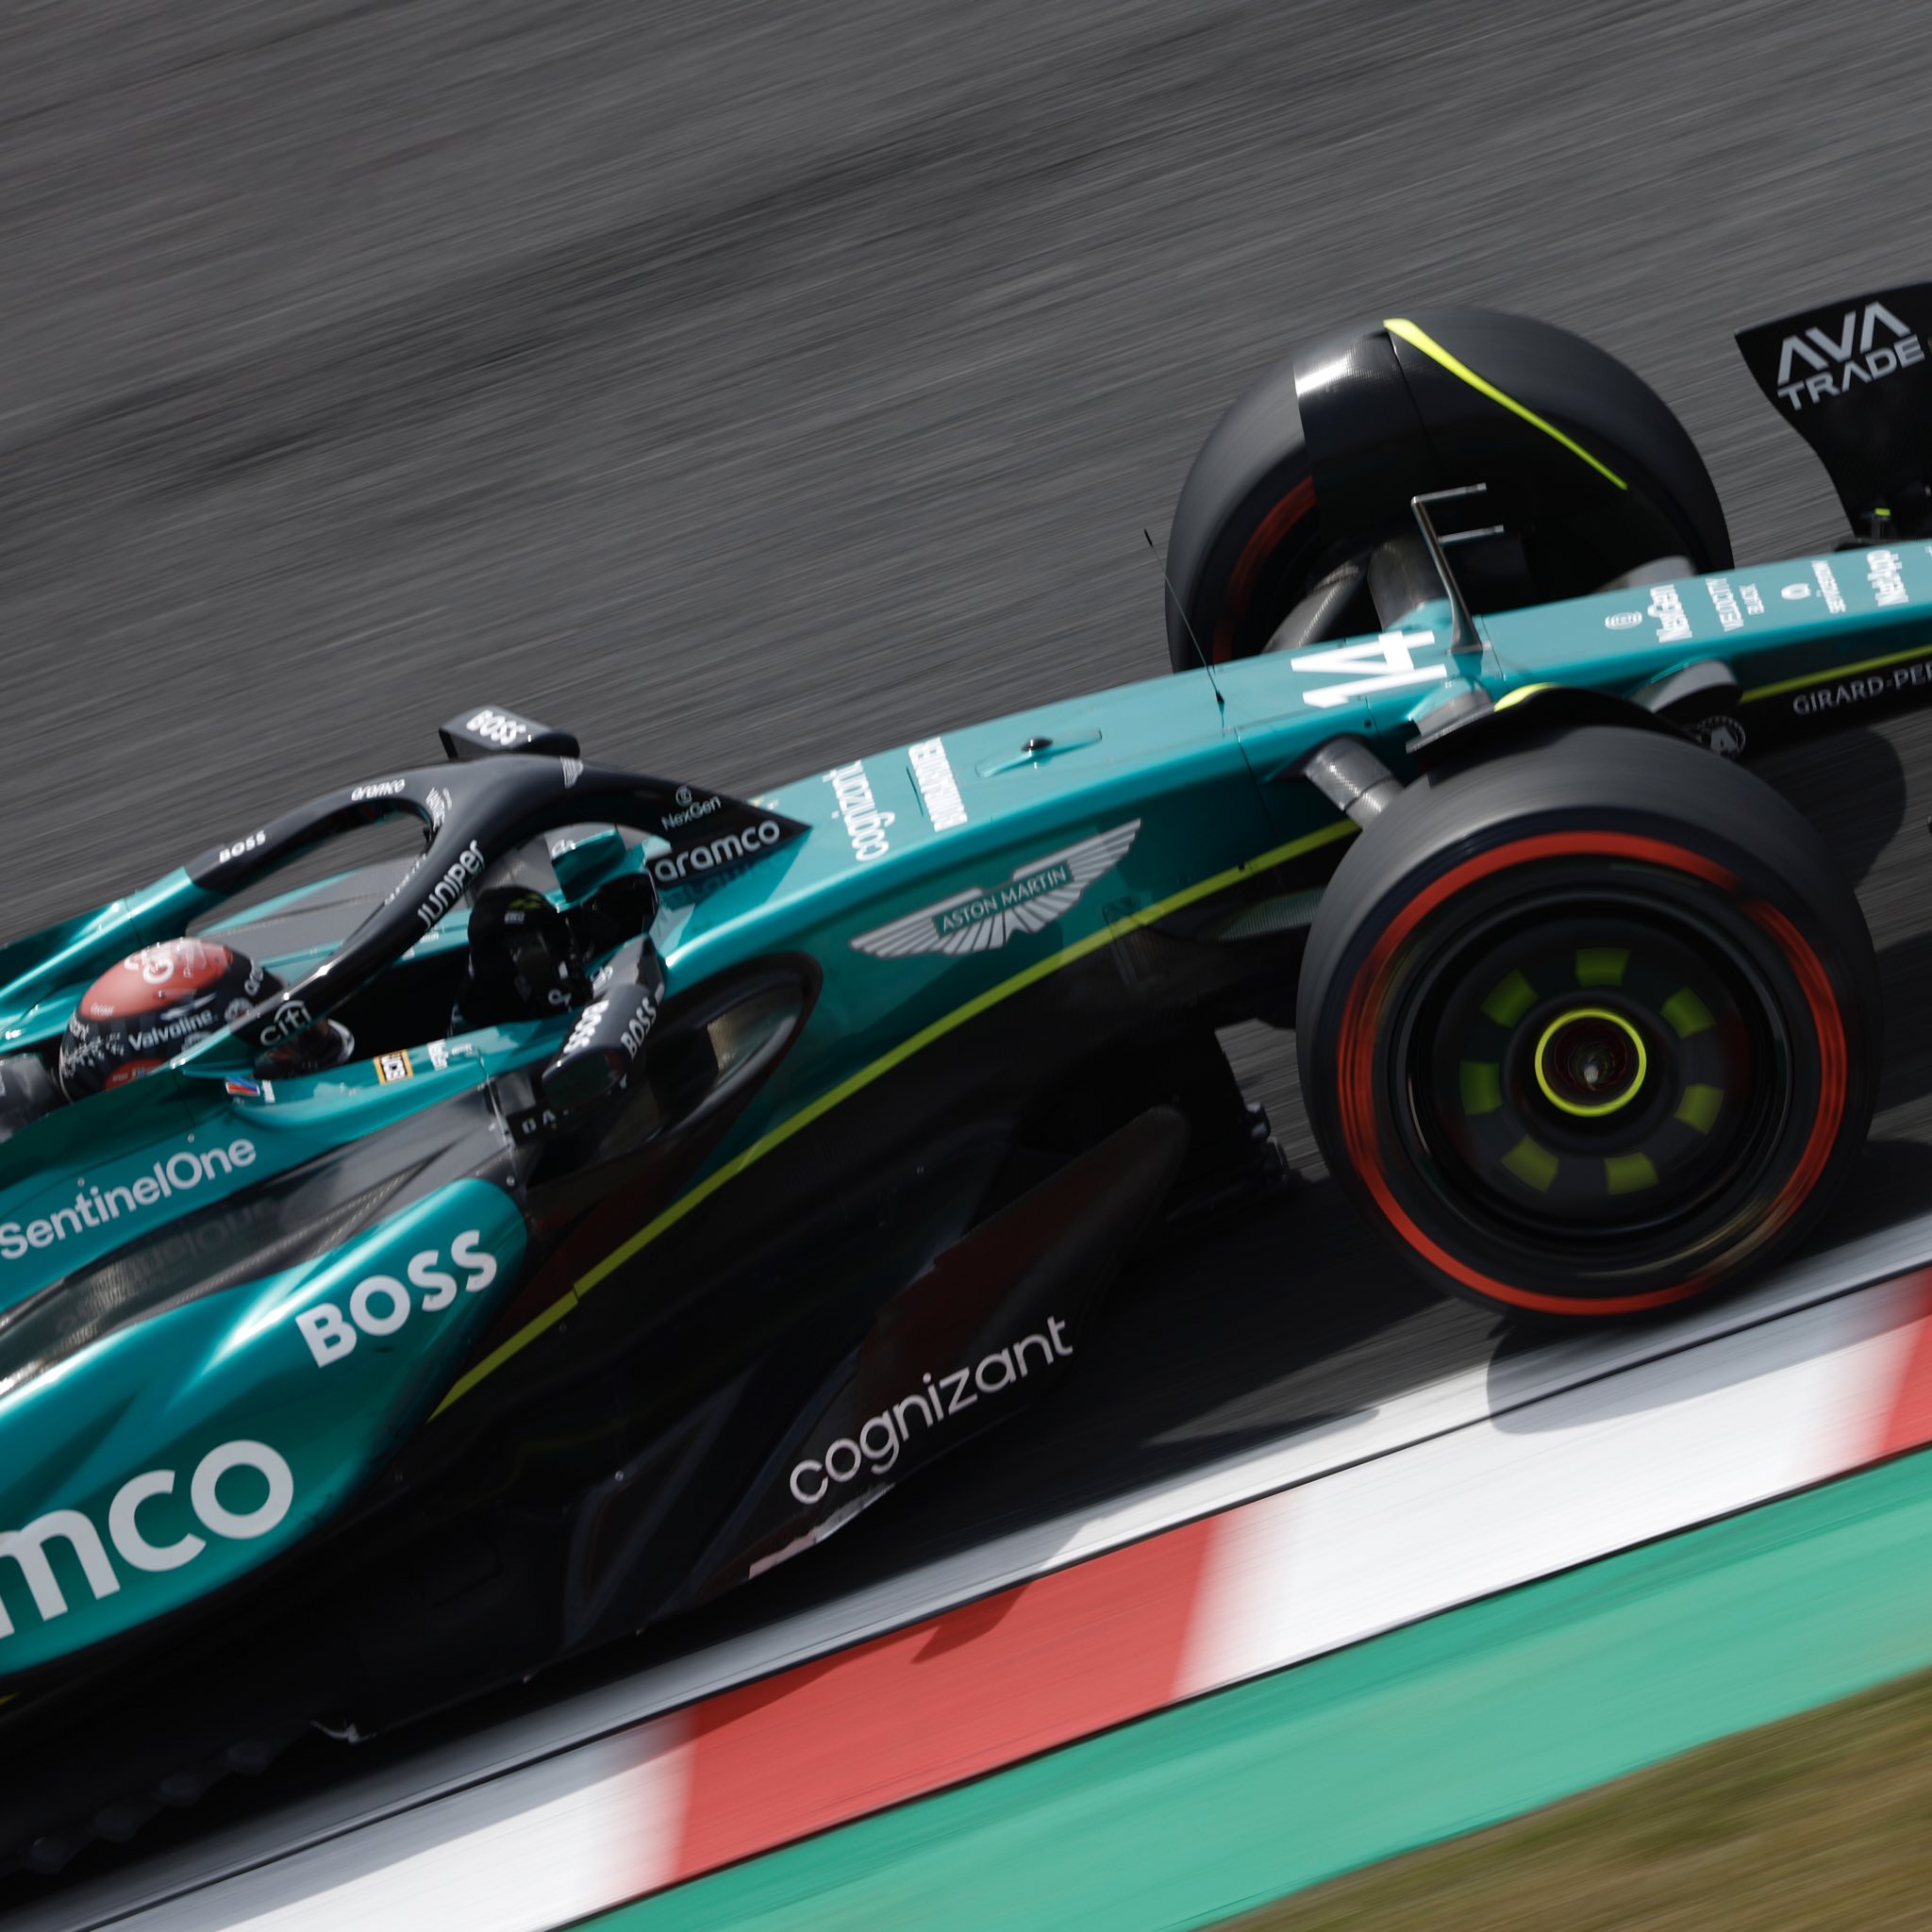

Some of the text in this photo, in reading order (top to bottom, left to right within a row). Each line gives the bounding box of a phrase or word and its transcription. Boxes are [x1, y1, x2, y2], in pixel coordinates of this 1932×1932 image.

[1777, 301, 1911, 387] AVA
[1777, 335, 1925, 410] TRADE
[1291, 630, 1447, 708] 14
[466, 709, 525, 745] BOSS
[219, 830, 266, 862] BOSS
[661, 795, 722, 831] NexGen
[655, 820, 781, 882] aramco
[942, 865, 1067, 933] ASTON MARTIN
[128, 1009, 214, 1051] Valvoline
[620, 996, 657, 1059] BOSS
[0, 1139, 257, 1259] SentinelOne
[295, 1229, 497, 1368] BOSS
[790, 1316, 1073, 1504] cognizant
